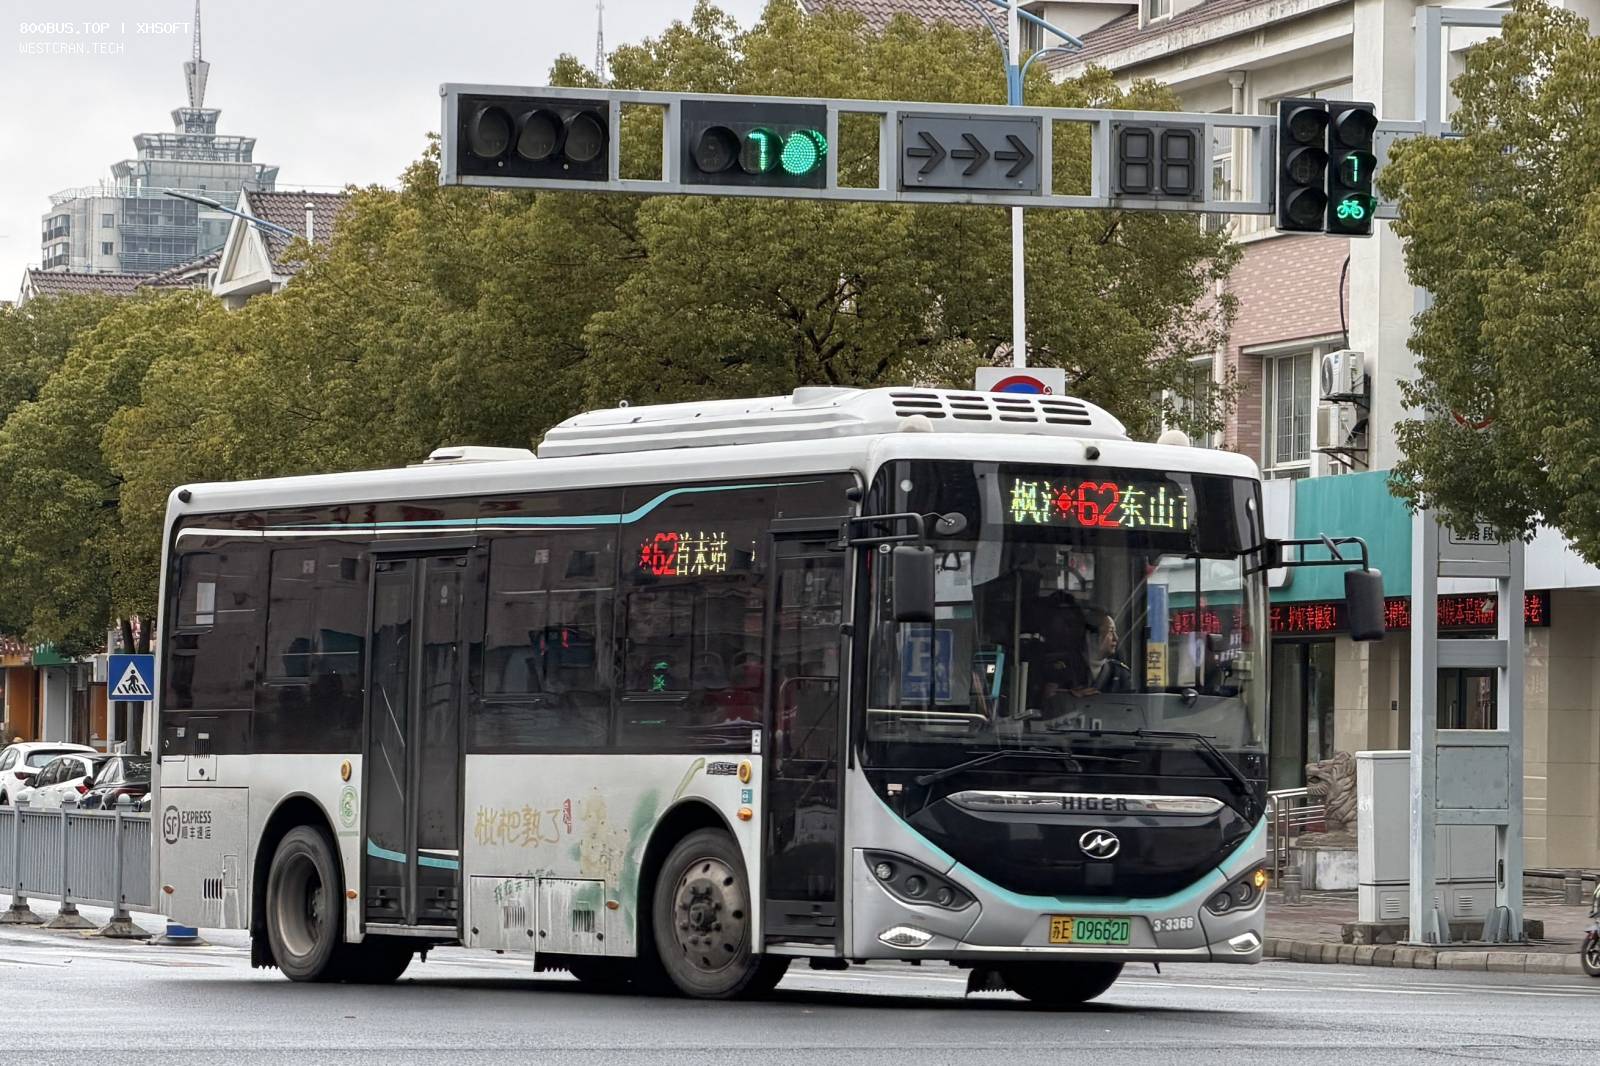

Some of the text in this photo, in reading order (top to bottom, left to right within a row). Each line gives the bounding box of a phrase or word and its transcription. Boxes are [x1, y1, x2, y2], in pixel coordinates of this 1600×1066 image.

[1078, 481, 1121, 527] 62
[1062, 796, 1129, 812] HIGER
[181, 811, 212, 824] EXPRESS
[1076, 920, 1129, 941] 09662D
